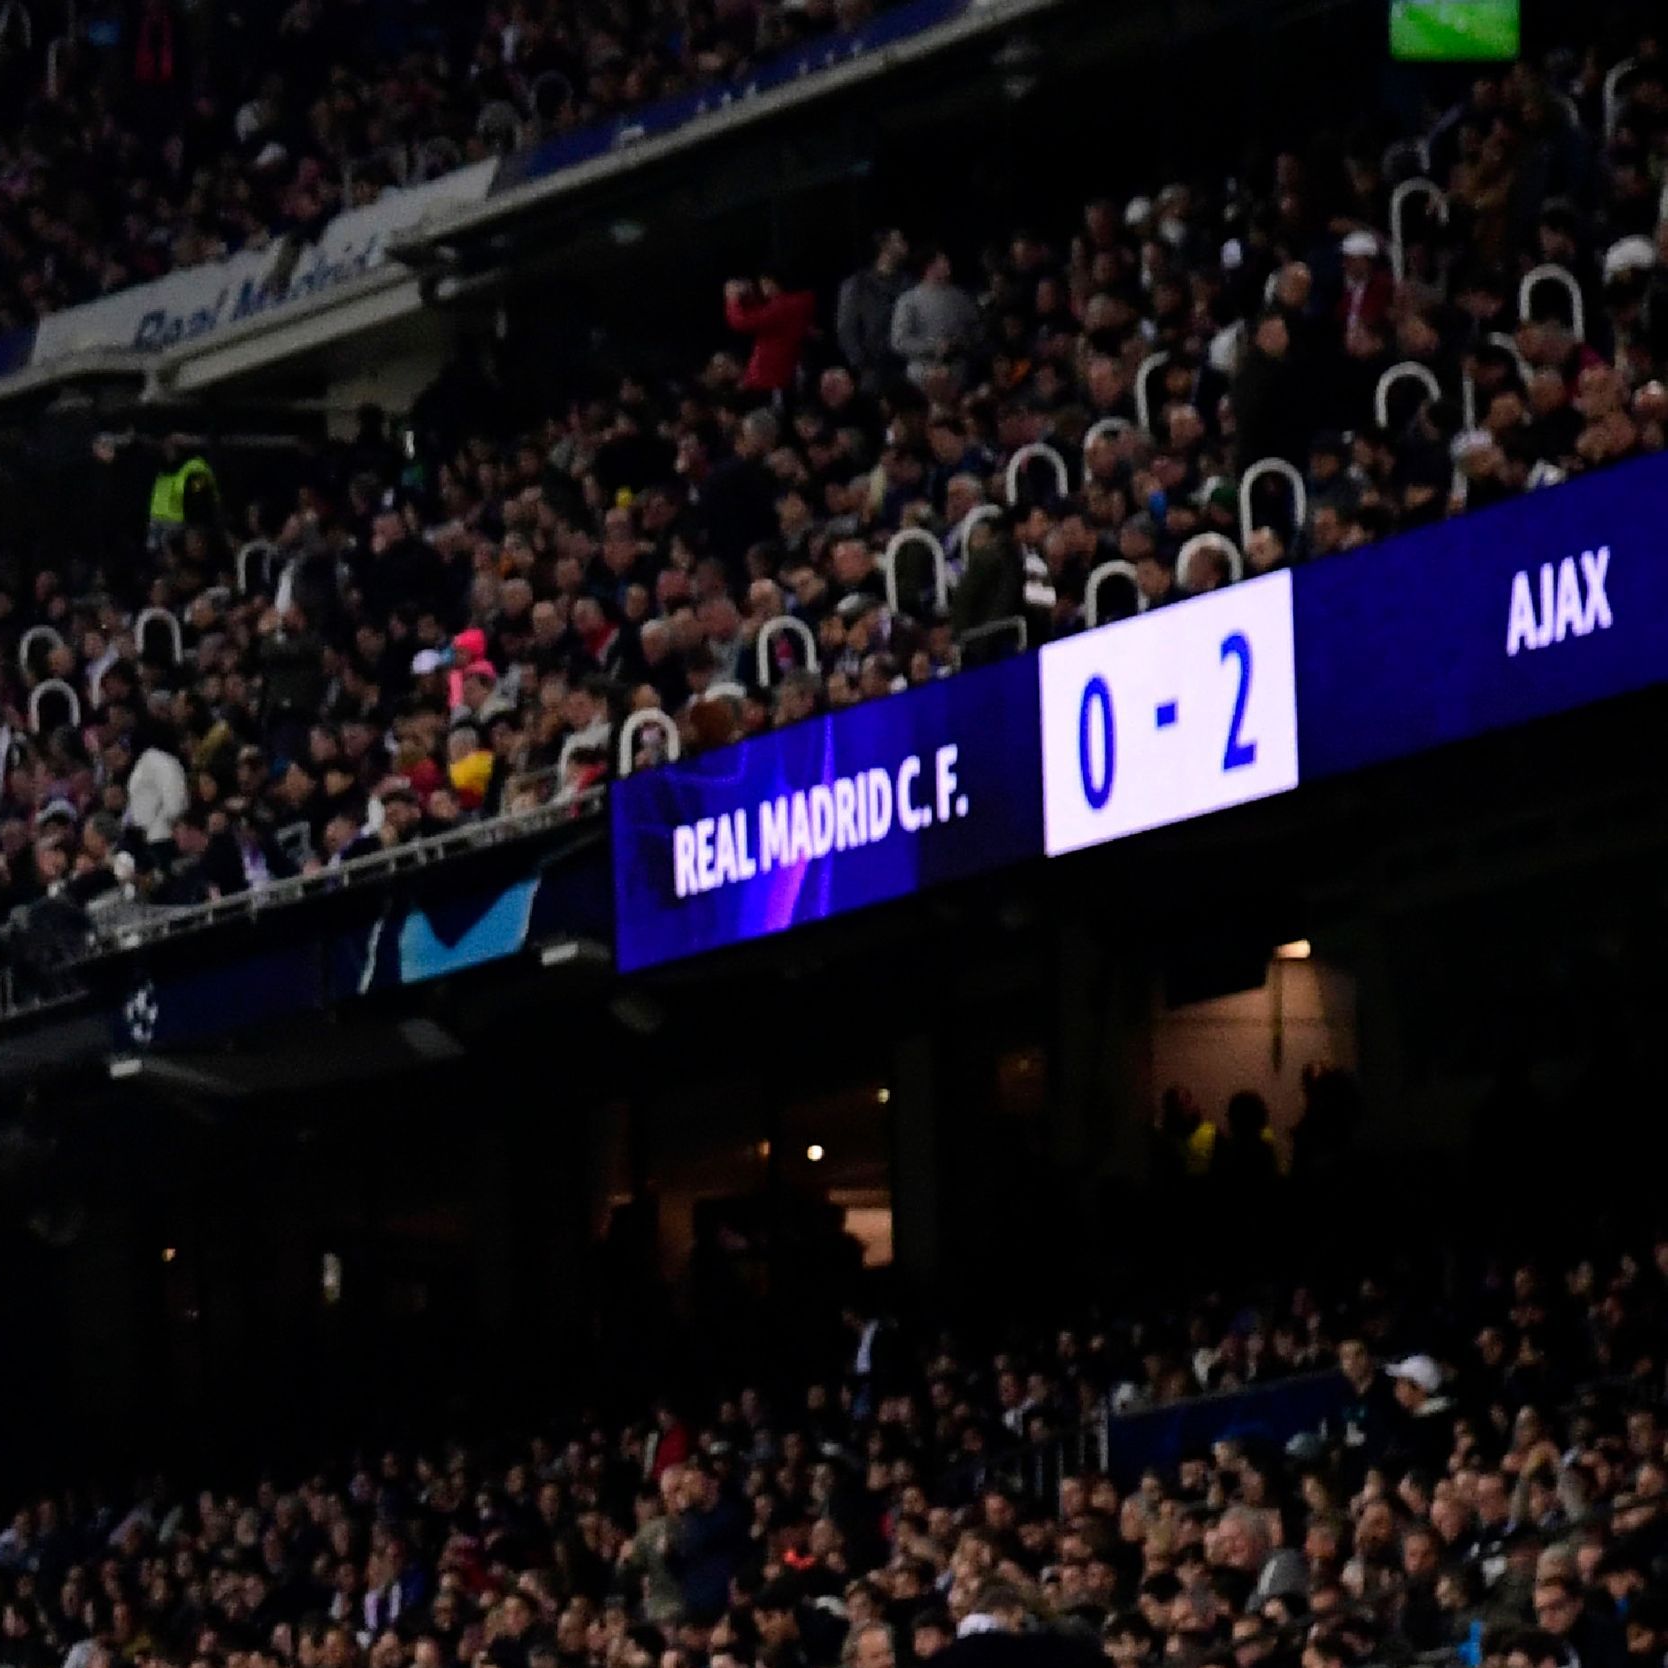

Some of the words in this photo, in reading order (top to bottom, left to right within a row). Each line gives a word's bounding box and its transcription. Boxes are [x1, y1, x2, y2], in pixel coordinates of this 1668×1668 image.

[1505, 544, 1614, 658] AJAX
[1078, 671, 1115, 811] 0
[1219, 629, 1258, 773] 2
[673, 807, 757, 899] REAL
[759, 767, 893, 876] MADRID
